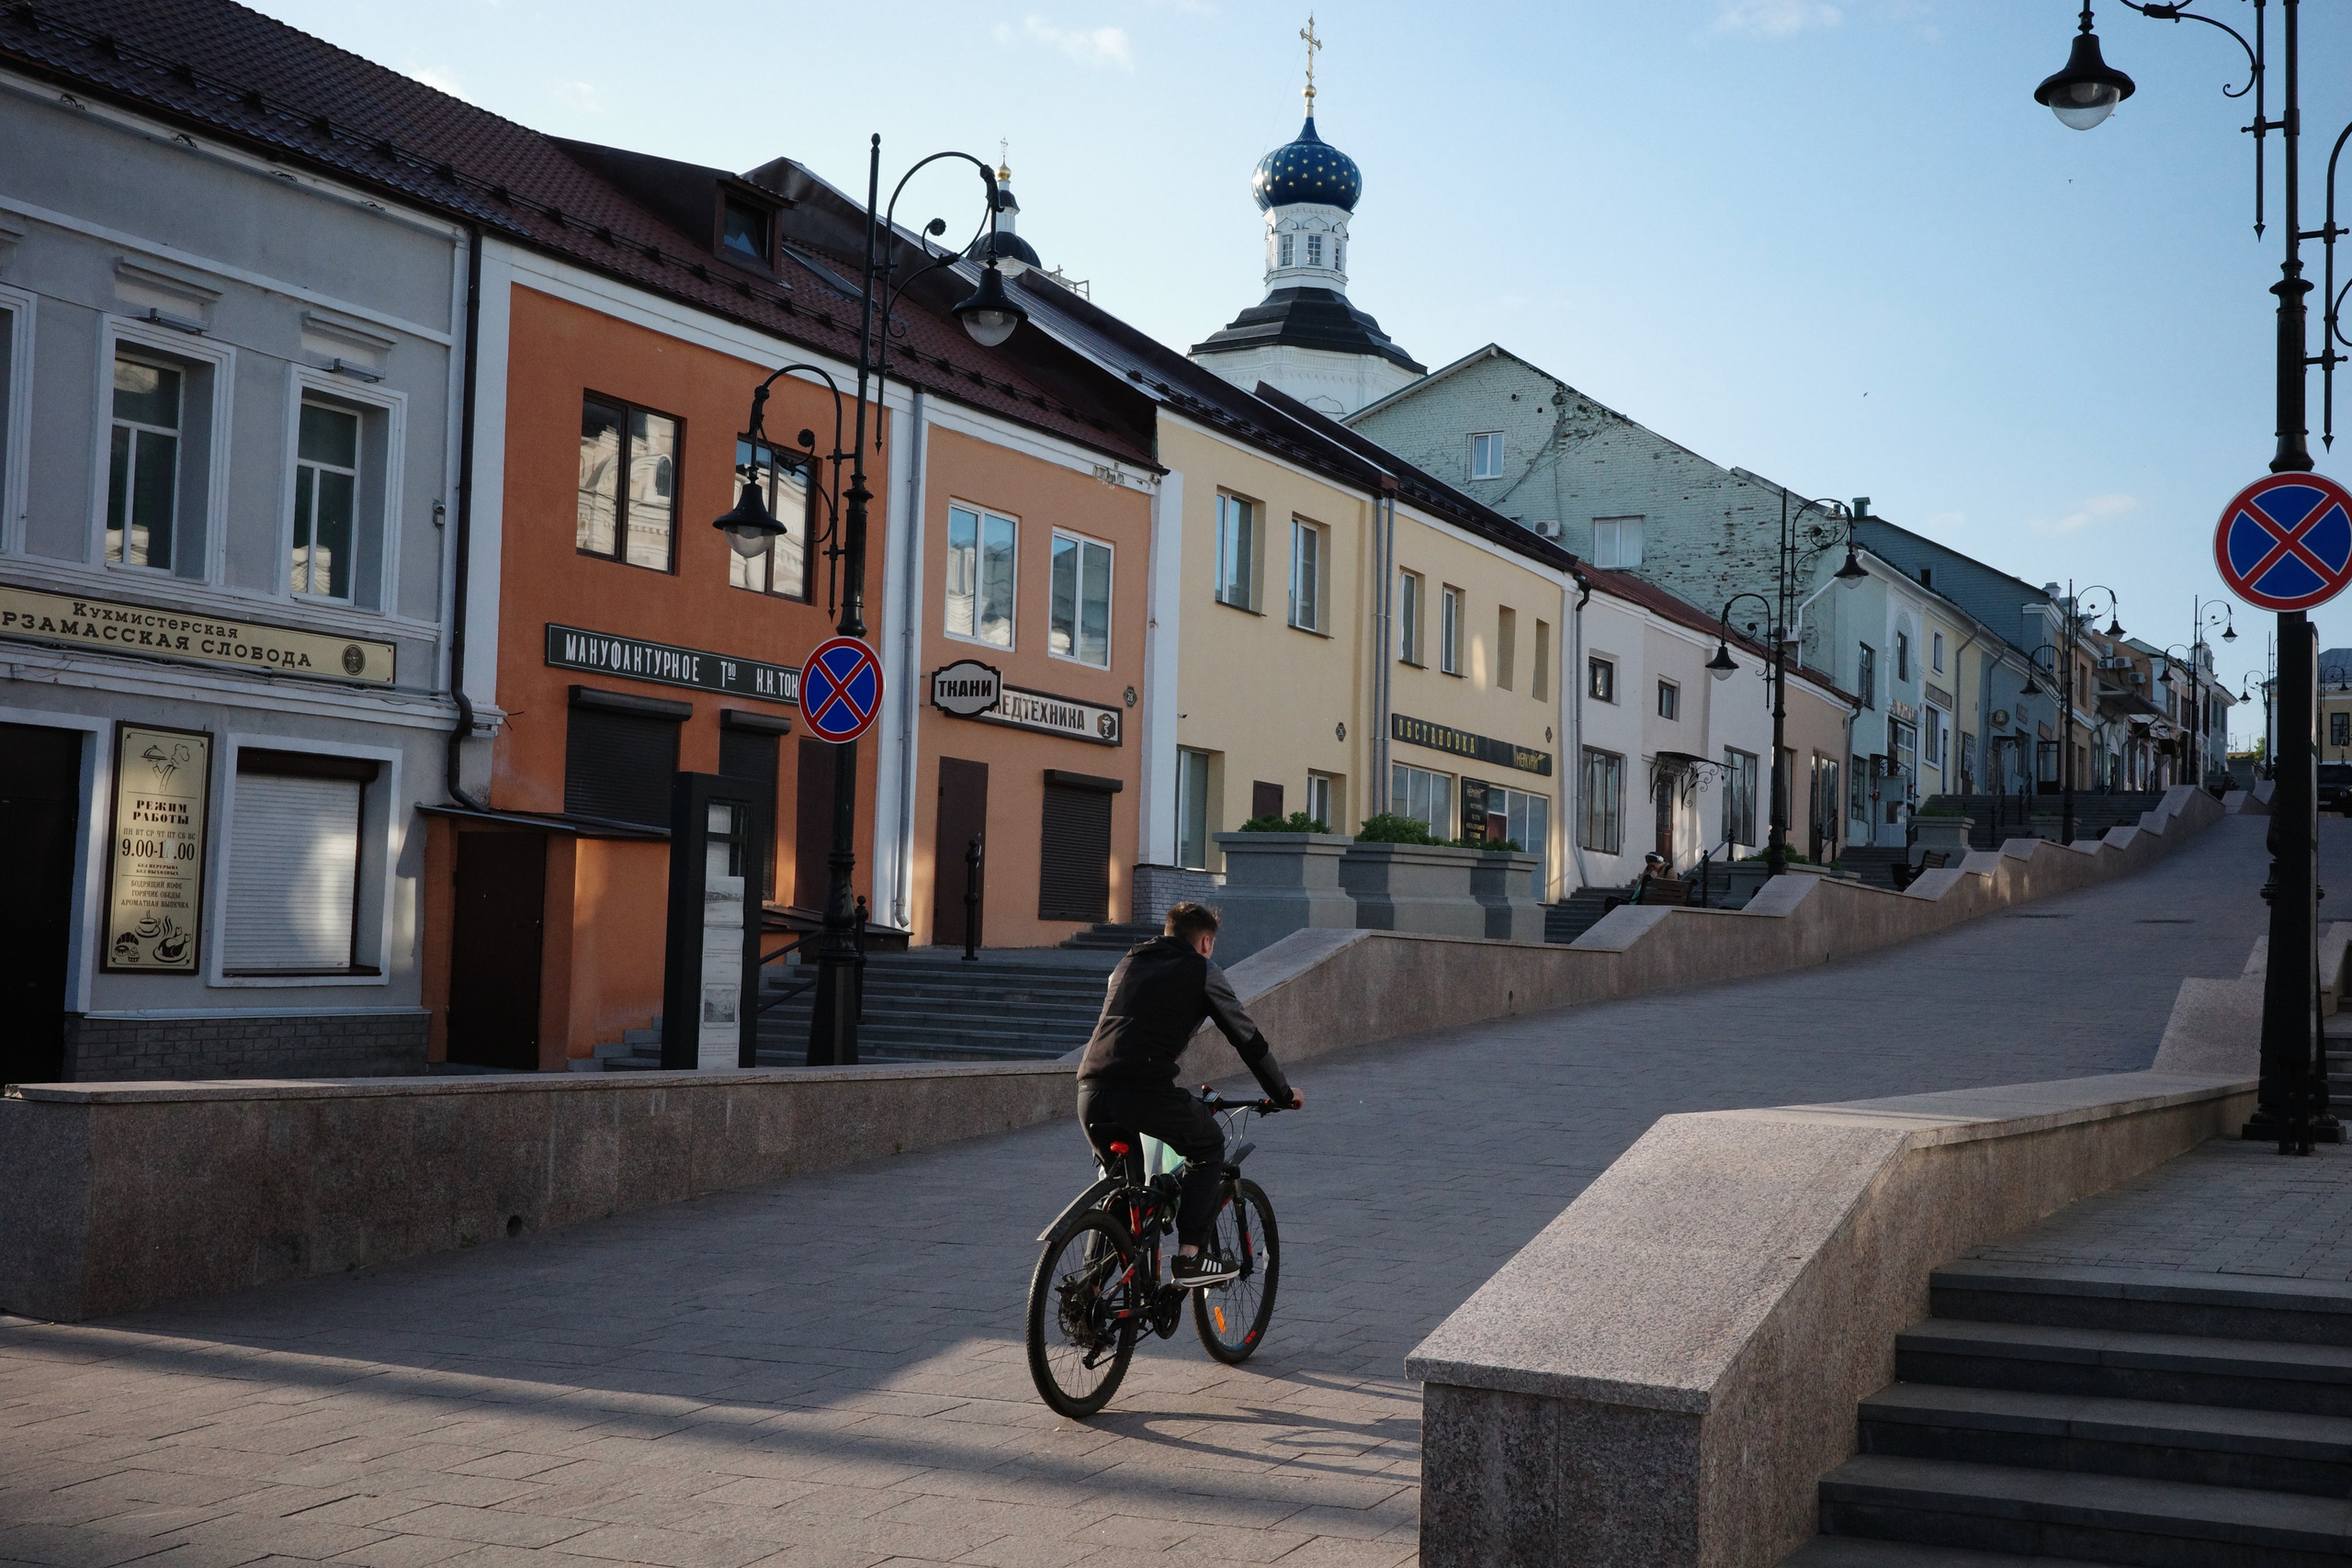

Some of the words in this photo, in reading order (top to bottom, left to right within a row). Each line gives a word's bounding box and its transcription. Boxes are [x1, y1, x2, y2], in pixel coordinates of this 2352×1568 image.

[73, 602, 238, 638] Кухмистерская
[2, 611, 189, 650] РЗАМАССКАЯ
[201, 639, 311, 669] СЛОБОДА
[565, 634, 700, 682] МАНУФАКТУРНОЕ
[778, 671, 799, 698] ТОК
[938, 680, 992, 697] ТКАНИ
[1398, 718, 1476, 754] ОБСТАНОВКА
[137, 800, 187, 813] РЕЖИМ
[133, 812, 188, 824] РАБОТЫ
[122, 838, 195, 861] 9.00-1.00
[130, 880, 164, 889] БОДРЯЩИЙ
[131, 889, 159, 897] ГОРЯЧИЕ
[160, 891, 181, 899] ОБЕДЫ
[120, 898, 159, 908] АРОМАТНАЯ
[161, 900, 189, 908] ВЫПЕЧКА
